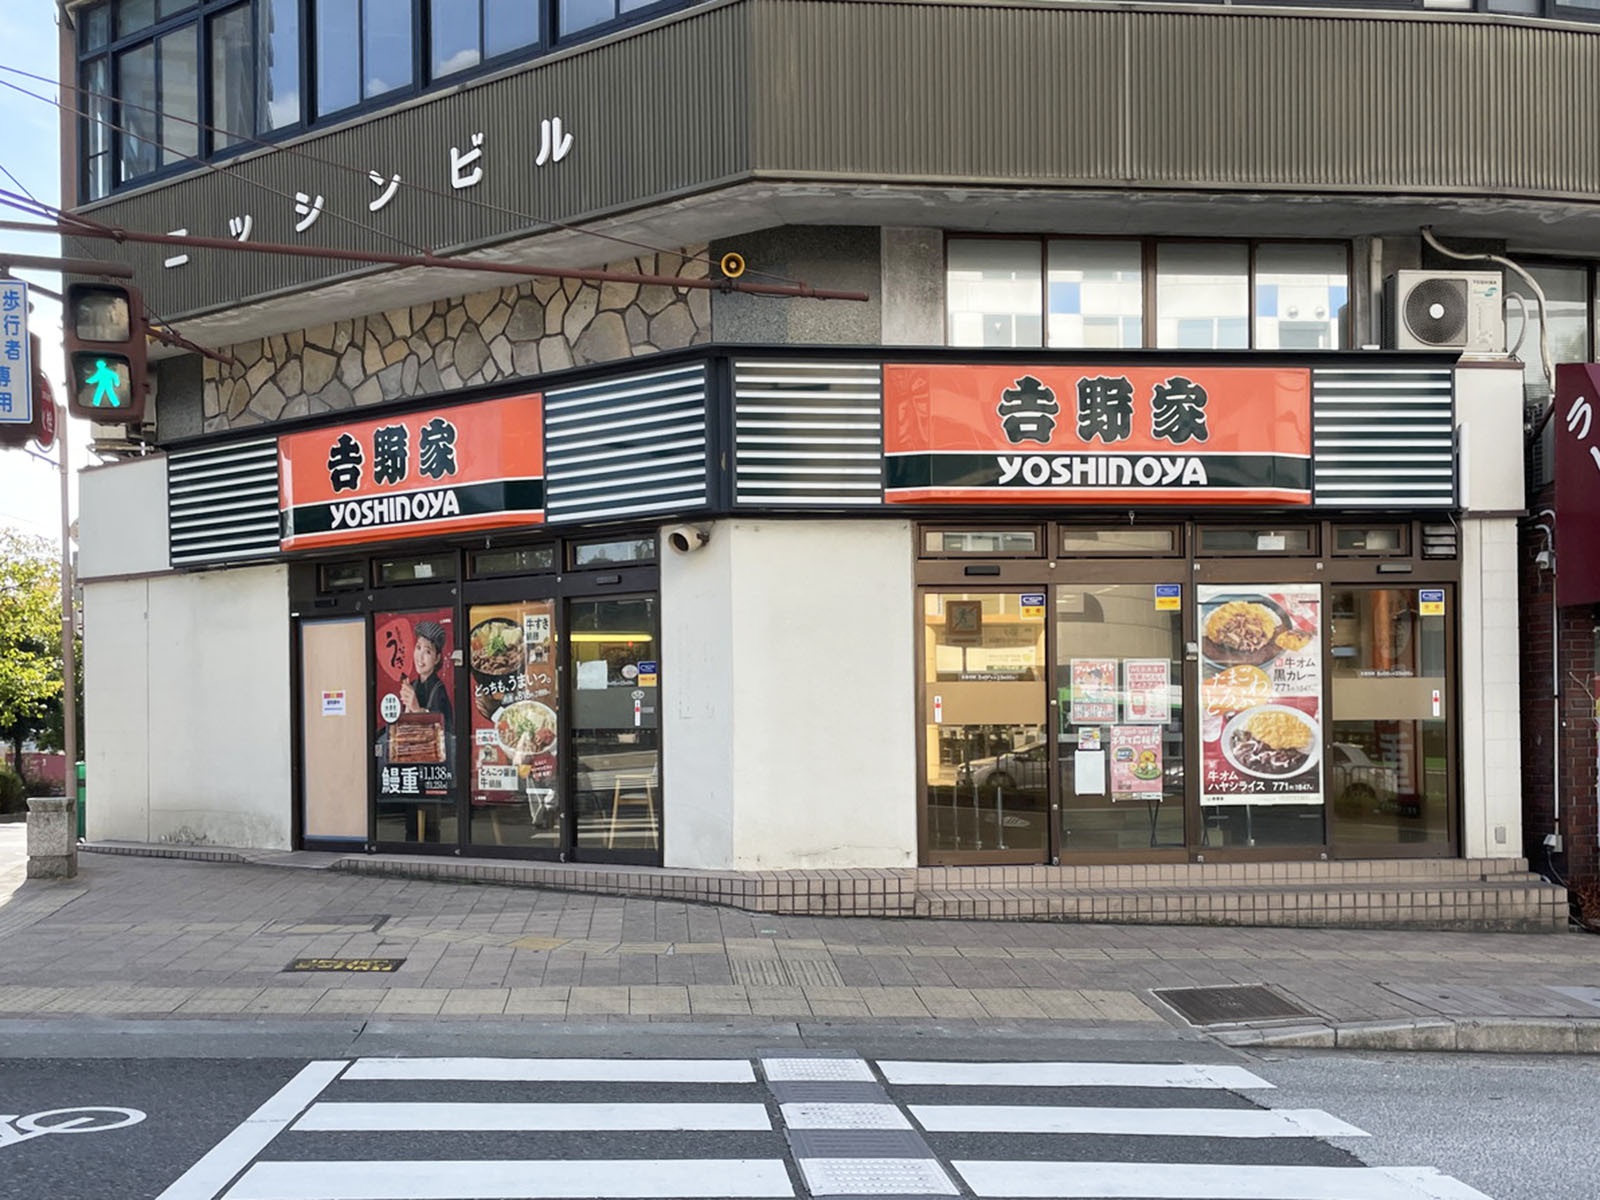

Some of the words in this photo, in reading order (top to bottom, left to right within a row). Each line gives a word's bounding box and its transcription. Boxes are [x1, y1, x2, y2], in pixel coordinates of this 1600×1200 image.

[164, 116, 573, 268] ニッシンビル
[996, 455, 1209, 486] YOSHINOYA
[330, 489, 460, 529] YOSHINOYA
[381, 766, 420, 794] 鰻重
[1207, 770, 1239, 782] 牛オム
[1208, 781, 1266, 792] ハヤシライス
